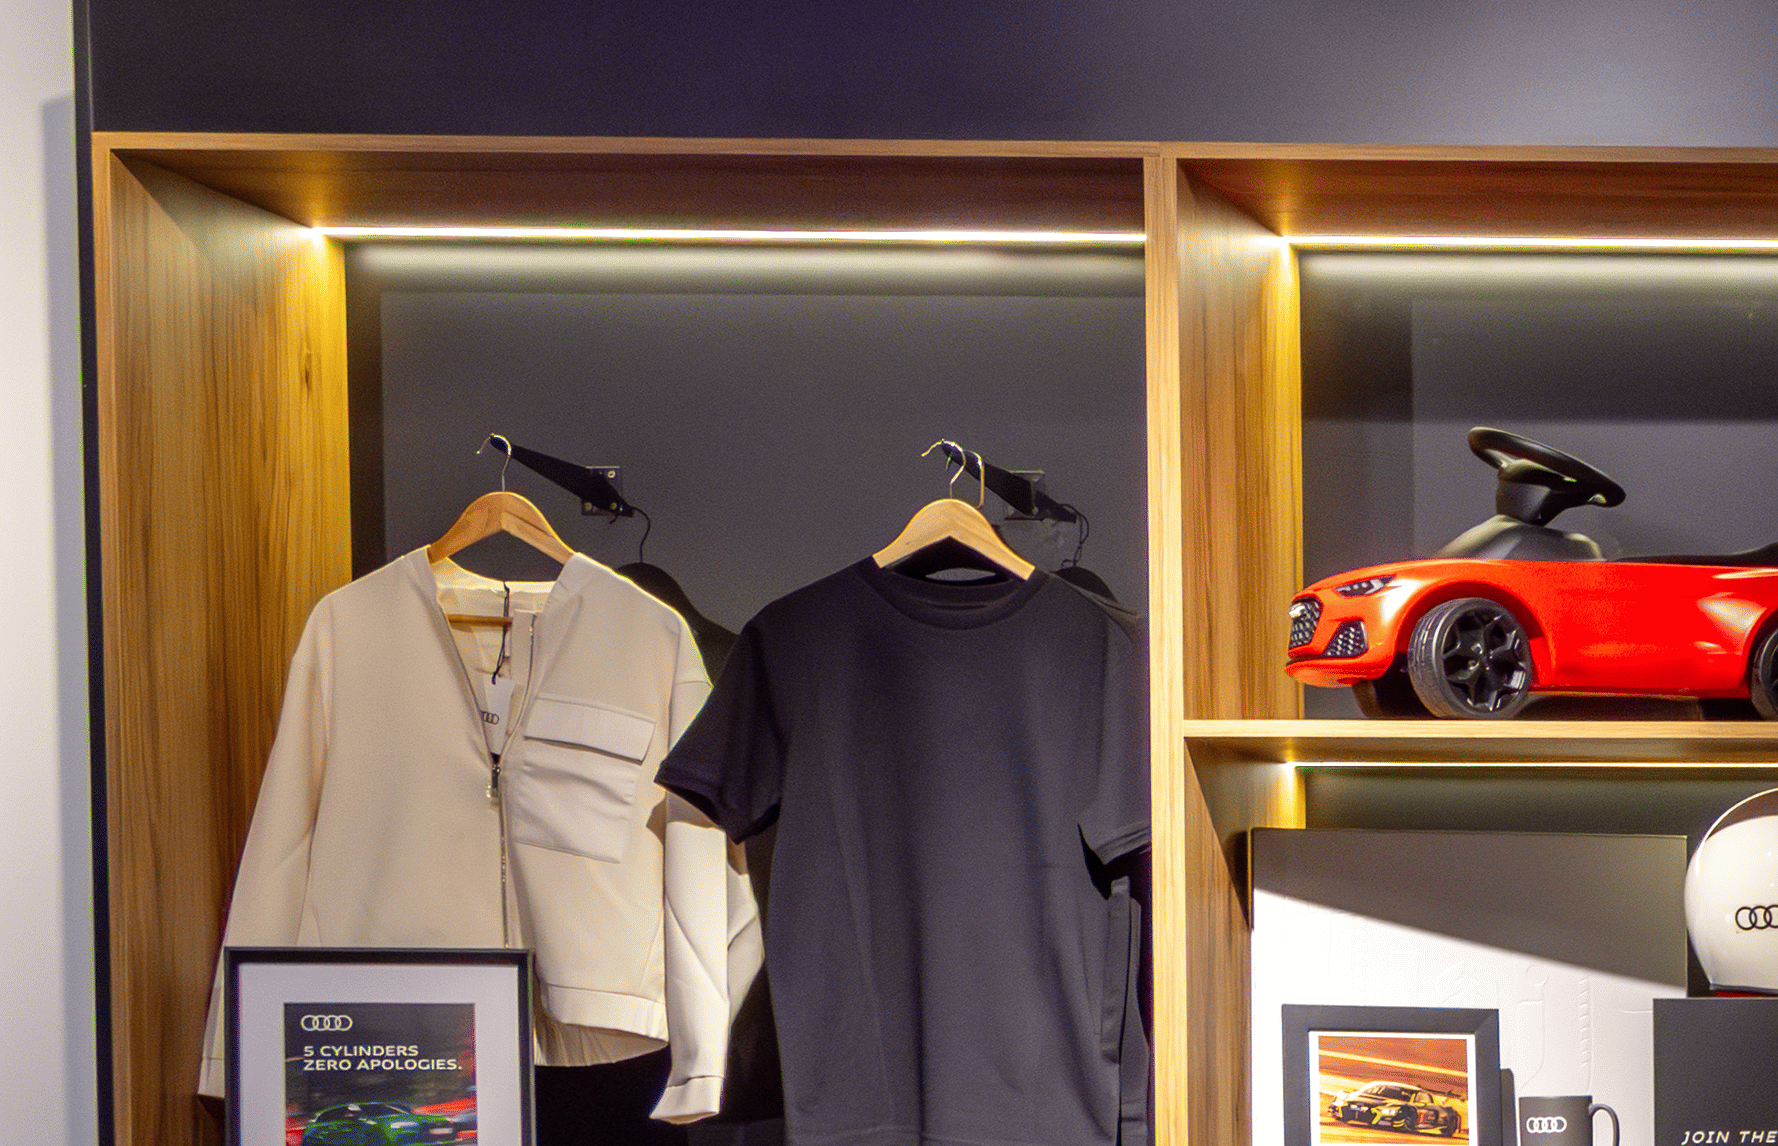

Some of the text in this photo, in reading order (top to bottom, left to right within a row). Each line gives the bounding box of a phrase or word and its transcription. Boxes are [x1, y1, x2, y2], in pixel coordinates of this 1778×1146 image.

[304, 1045, 419, 1057] 5 CYLINDERS
[303, 1059, 462, 1071] ZERO APOLOGIES.
[1681, 1131, 1730, 1146] JOIN
[1739, 1131, 1778, 1143] THE
